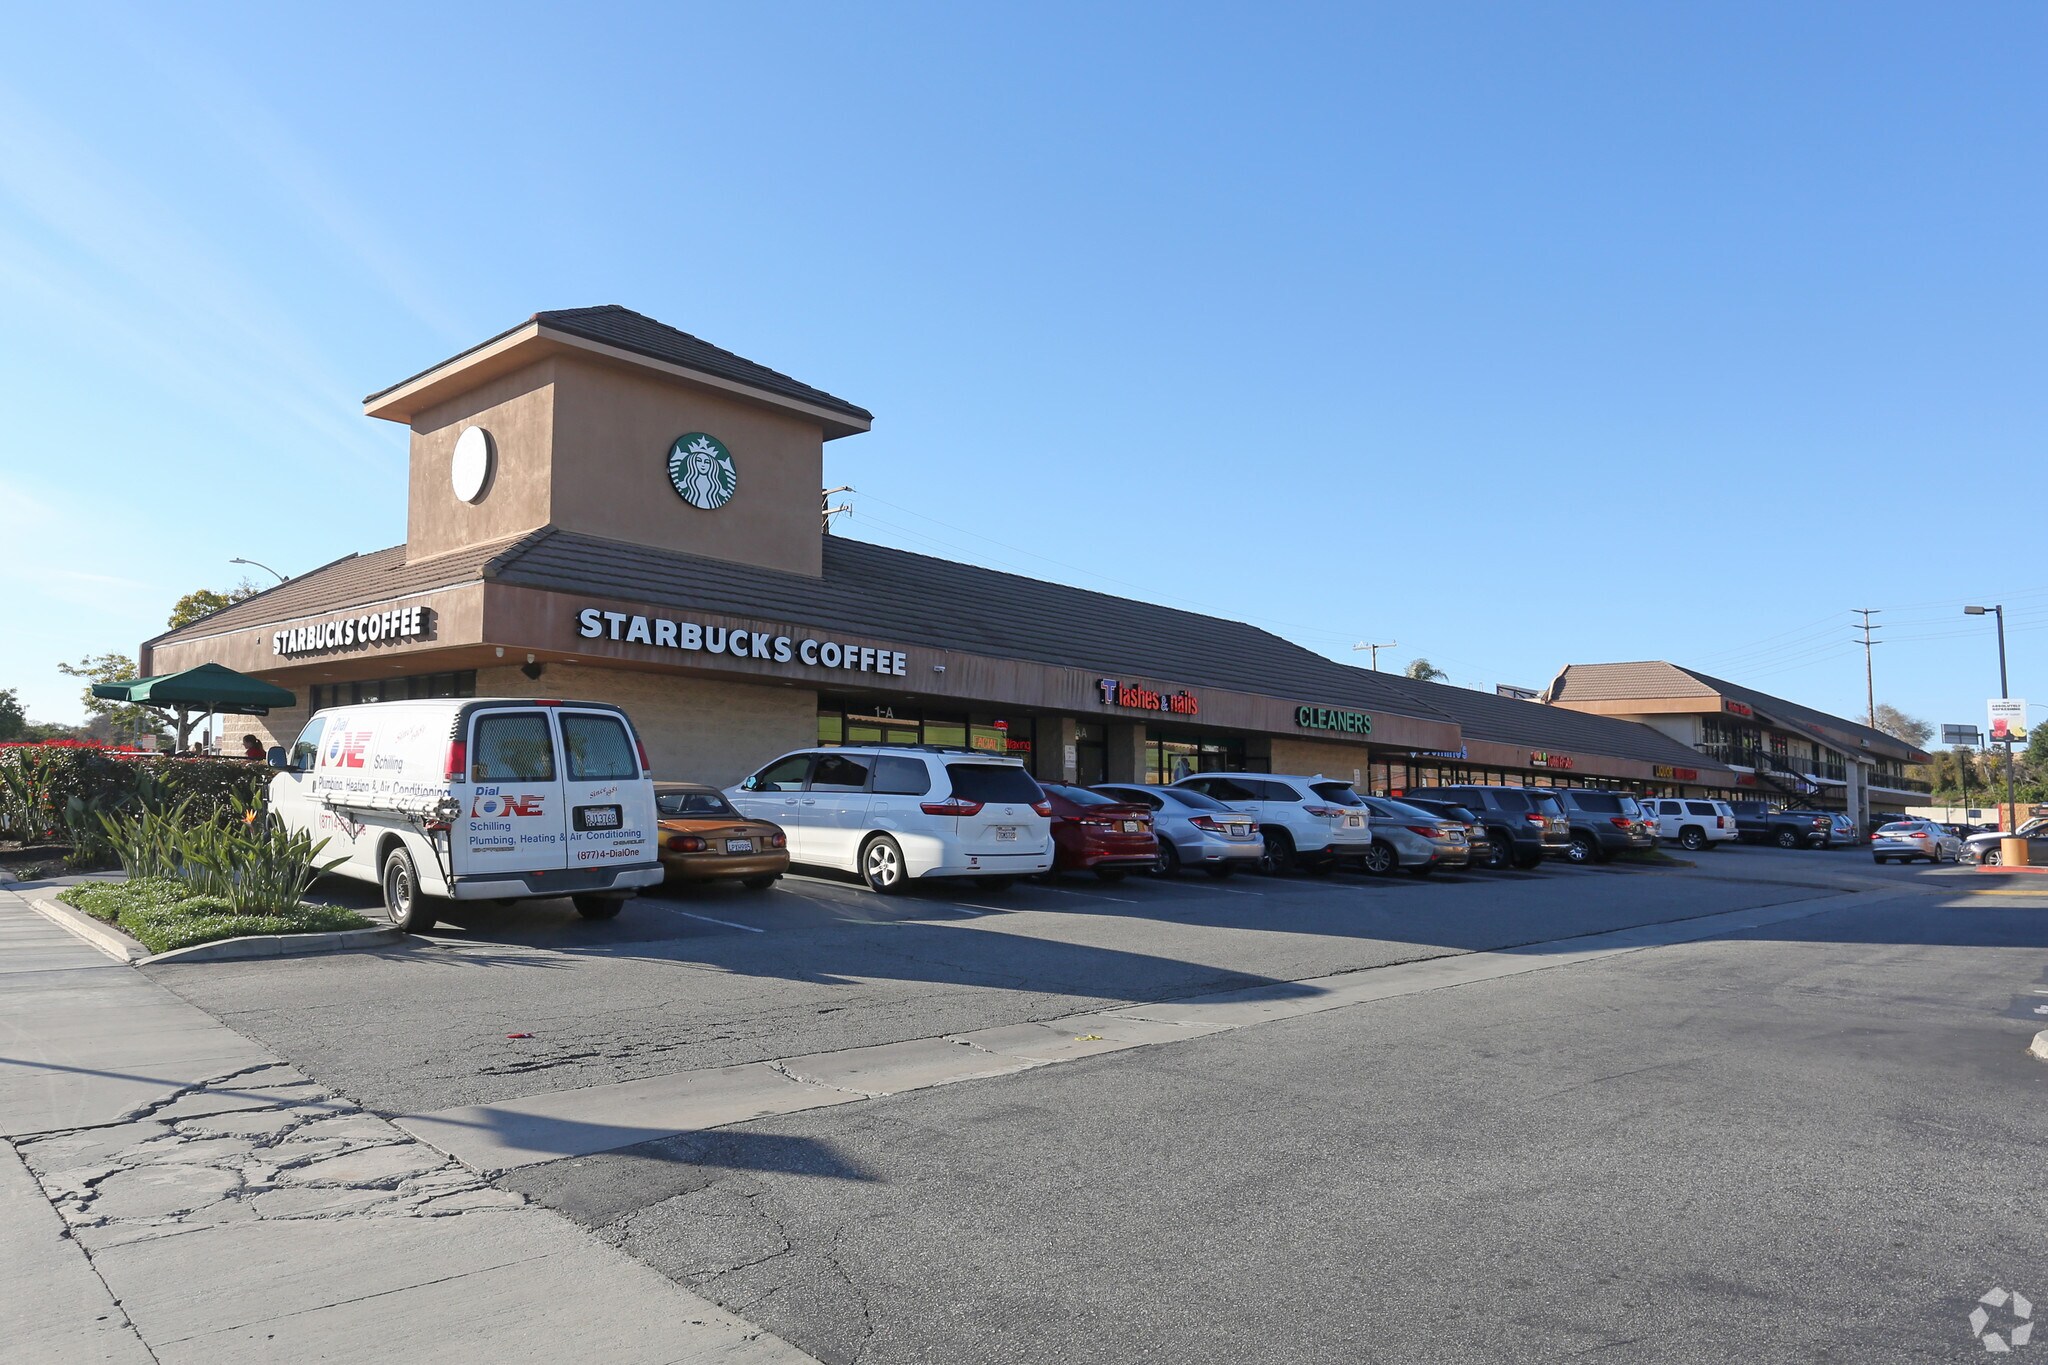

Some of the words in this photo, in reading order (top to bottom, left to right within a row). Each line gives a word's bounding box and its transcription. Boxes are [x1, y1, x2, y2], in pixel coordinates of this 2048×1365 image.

[273, 618, 354, 655] STARBUCKS
[357, 606, 421, 643] COFFEE
[579, 608, 792, 663] STARBUCKS
[799, 638, 907, 676] COFFEE
[1100, 678, 1117, 704] T
[1119, 681, 1159, 710] lashes
[1160, 695, 1169, 712] &
[1170, 690, 1198, 715] nails
[874, 706, 894, 719] 1-A
[1299, 706, 1372, 734] CLEANERS
[974, 736, 998, 751] FACIAL
[374, 755, 403, 773] Schilling
[380, 782, 390, 792] Air
[475, 787, 499, 795] Dial
[589, 786, 607, 799] Since
[471, 795, 545, 818] ONE
[470, 822, 511, 832] Schilling
[470, 836, 516, 845] Plumbing,
[520, 834, 556, 844] Heating
[570, 832, 582, 841] Air
[586, 829, 642, 840] Conditioning
